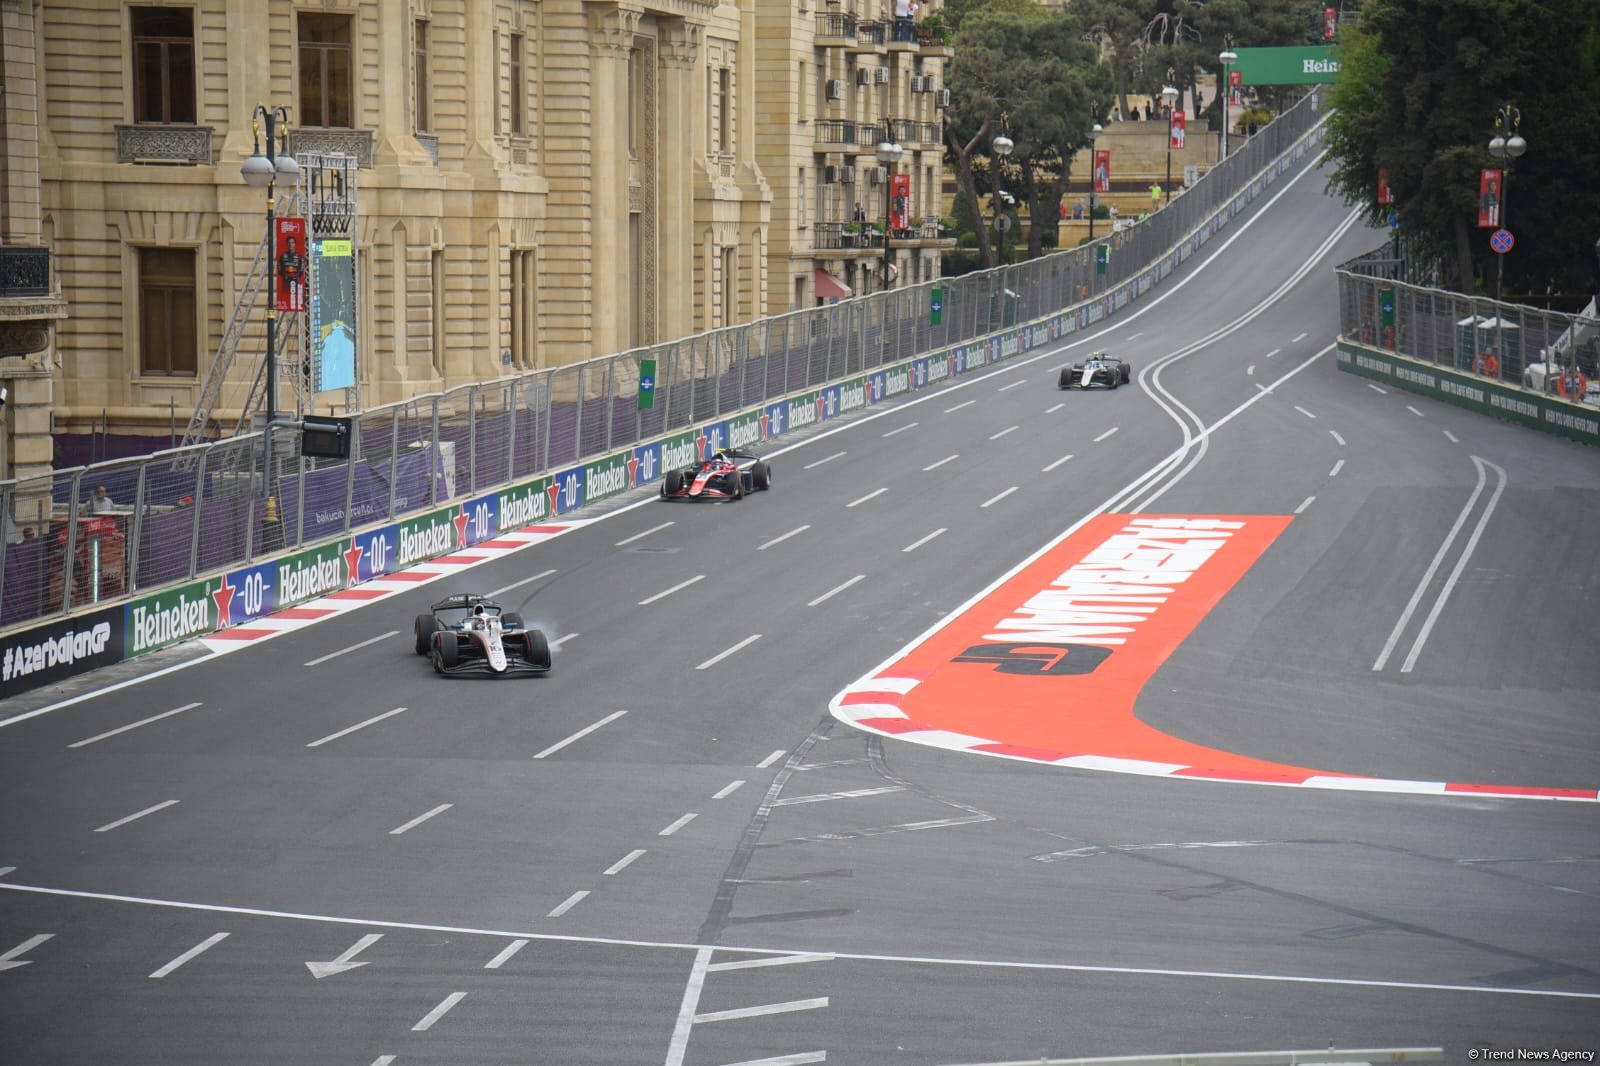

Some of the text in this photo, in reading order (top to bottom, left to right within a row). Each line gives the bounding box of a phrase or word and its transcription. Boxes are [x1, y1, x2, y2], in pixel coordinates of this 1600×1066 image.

[729, 416, 759, 449] Heineken
[661, 438, 695, 474] Heineken
[586, 462, 625, 500] Heineken
[500, 488, 545, 530] Heineken
[400, 518, 451, 565] Heineken
[279, 554, 341, 605] Heineken
[133, 594, 209, 652] Heineken
[3, 621, 111, 681] #AzerbaijanGP
